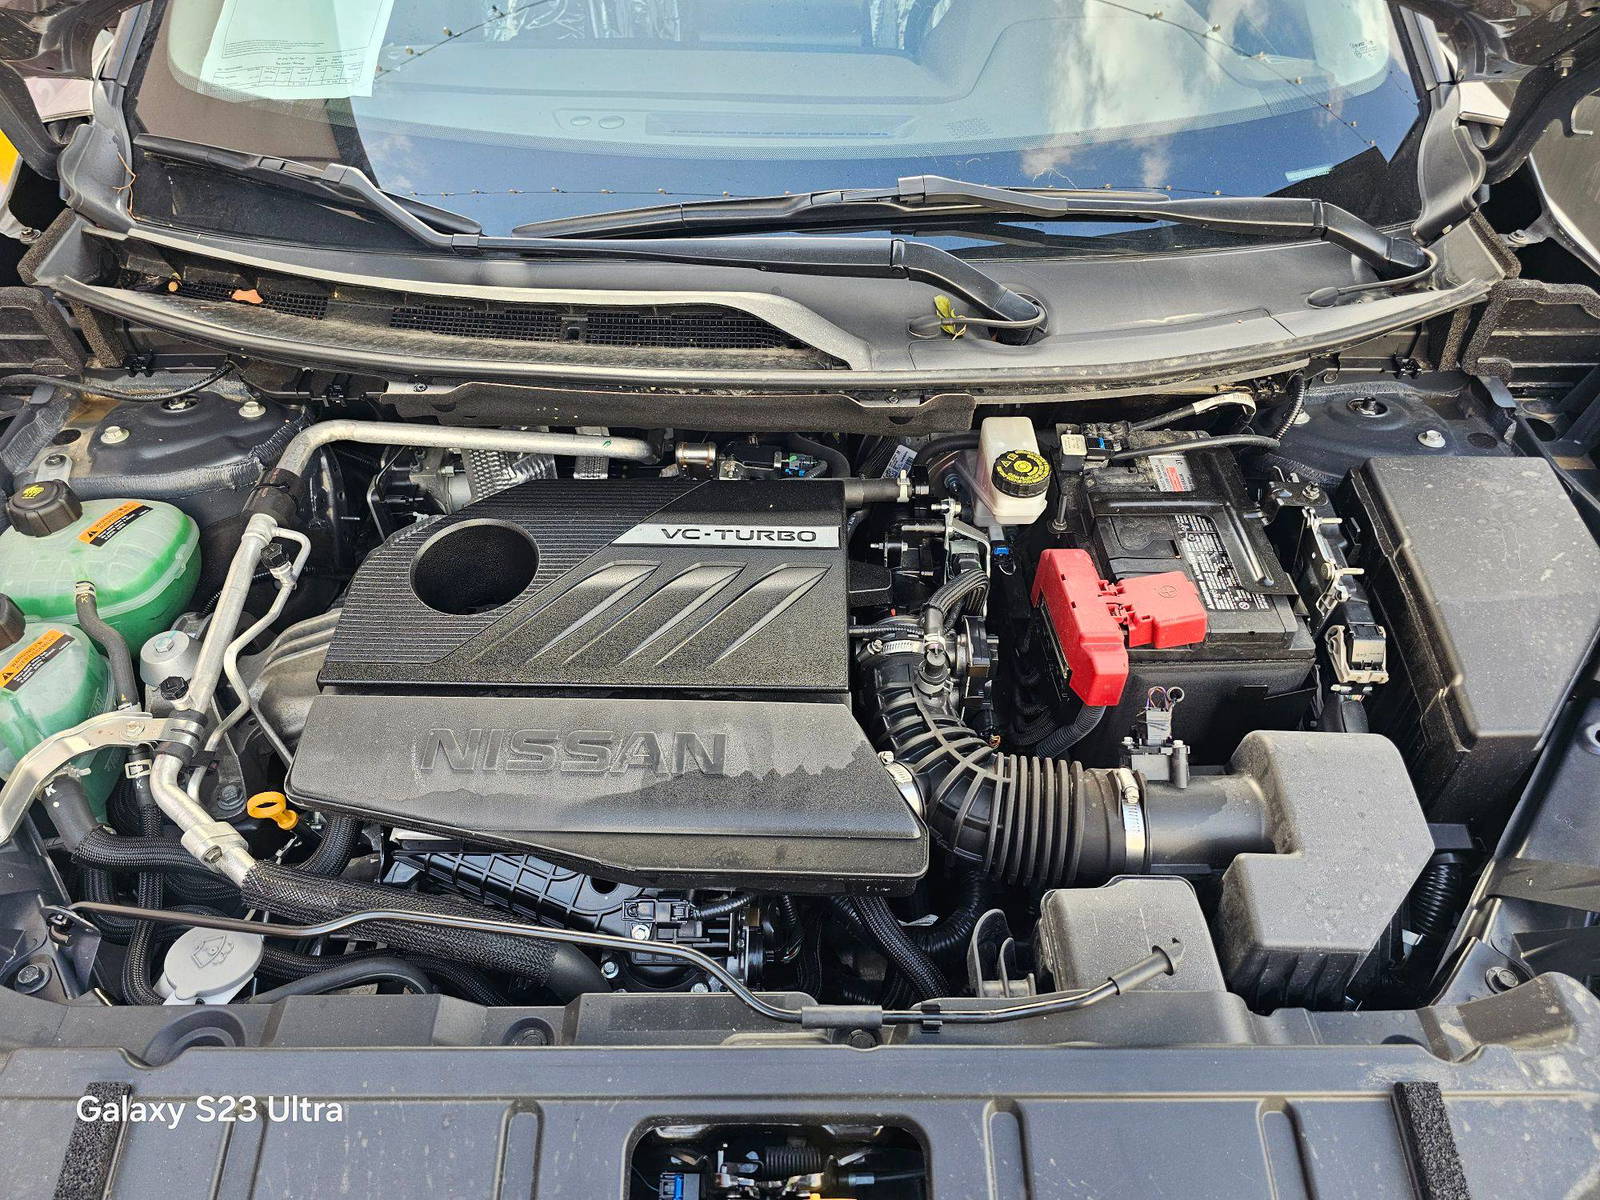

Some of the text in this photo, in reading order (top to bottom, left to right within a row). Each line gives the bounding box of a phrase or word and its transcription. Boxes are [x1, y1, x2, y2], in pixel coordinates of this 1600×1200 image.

[661, 528, 817, 543] VC-TURBO
[420, 728, 728, 775] NISSAN
[44, 783, 57, 798] K
